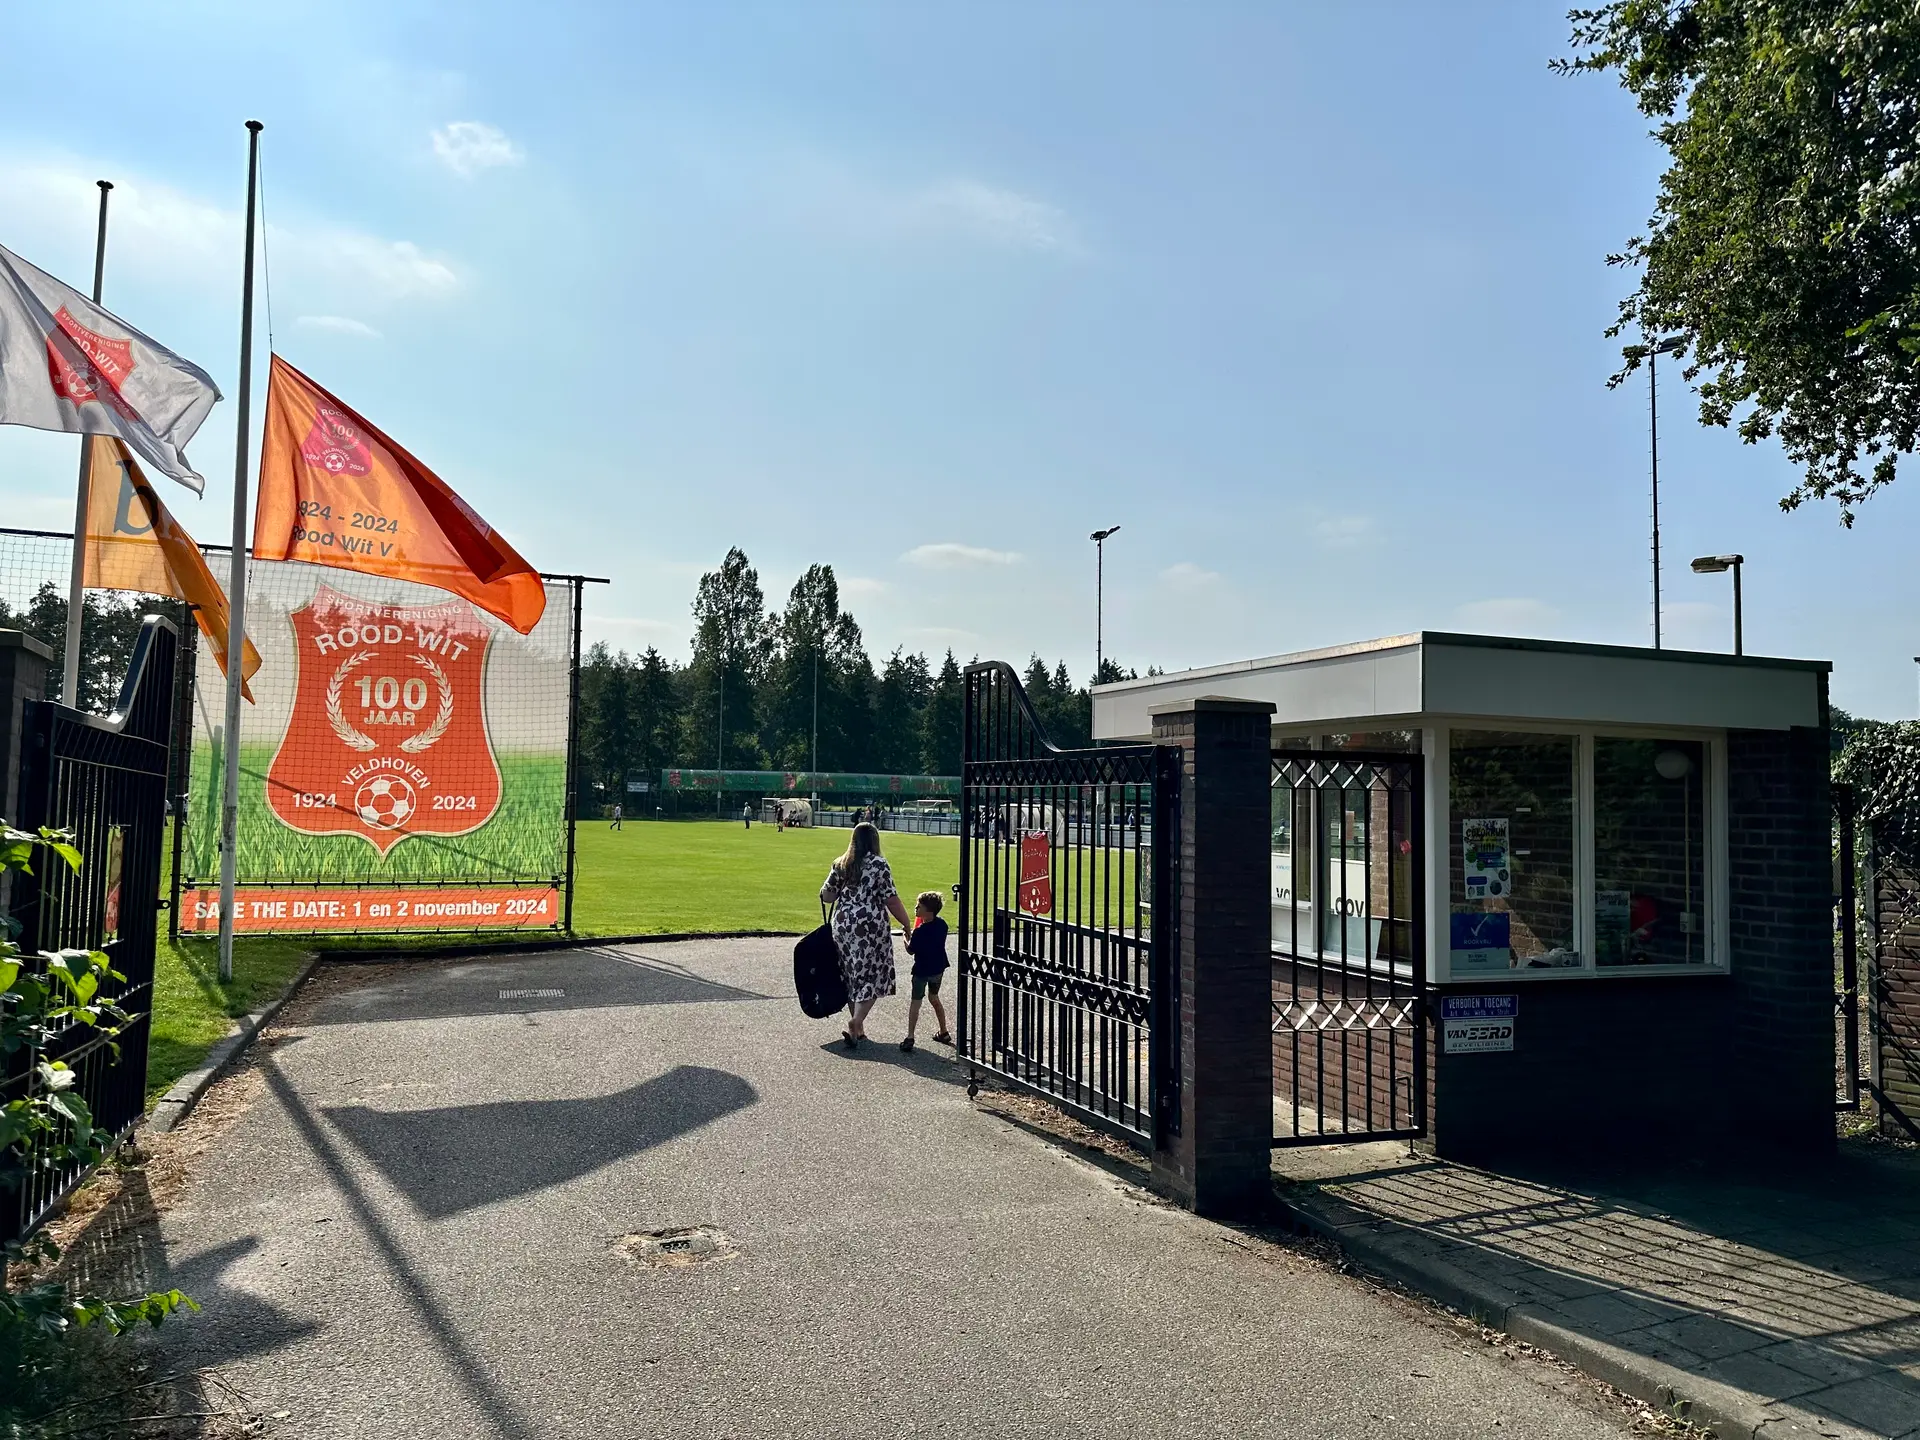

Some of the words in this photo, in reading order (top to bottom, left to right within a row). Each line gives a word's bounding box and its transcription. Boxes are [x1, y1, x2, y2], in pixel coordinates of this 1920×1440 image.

[62, 312, 125, 350] SPORTVERENIGING
[72, 336, 121, 375] OD-WIT
[331, 424, 355, 438] 100
[349, 463, 364, 472] 2024
[299, 500, 332, 521] 924
[350, 512, 399, 534] 2024
[341, 534, 374, 555] Wit
[380, 541, 394, 558] V
[326, 593, 463, 621] SPORTVERENIGING
[314, 624, 470, 663] ROOD-WIT
[353, 675, 429, 711] 100
[363, 710, 416, 726] JAAR
[341, 757, 432, 790] VELDHOVEN
[292, 793, 337, 809] 1924
[432, 794, 477, 811] 2024
[194, 901, 245, 919] SAE
[250, 901, 286, 918] THE
[294, 901, 346, 918] DATE:
[352, 901, 361, 917] 1
[369, 904, 389, 918] en
[396, 901, 408, 917] 2
[414, 899, 502, 917] november
[506, 897, 548, 916] 2024
[1448, 997, 1480, 1009] VERBODEN
[1483, 996, 1511, 1009] TOEGANG
[1447, 1030, 1469, 1039] VAN
[1468, 1027, 1512, 1040] EERD
